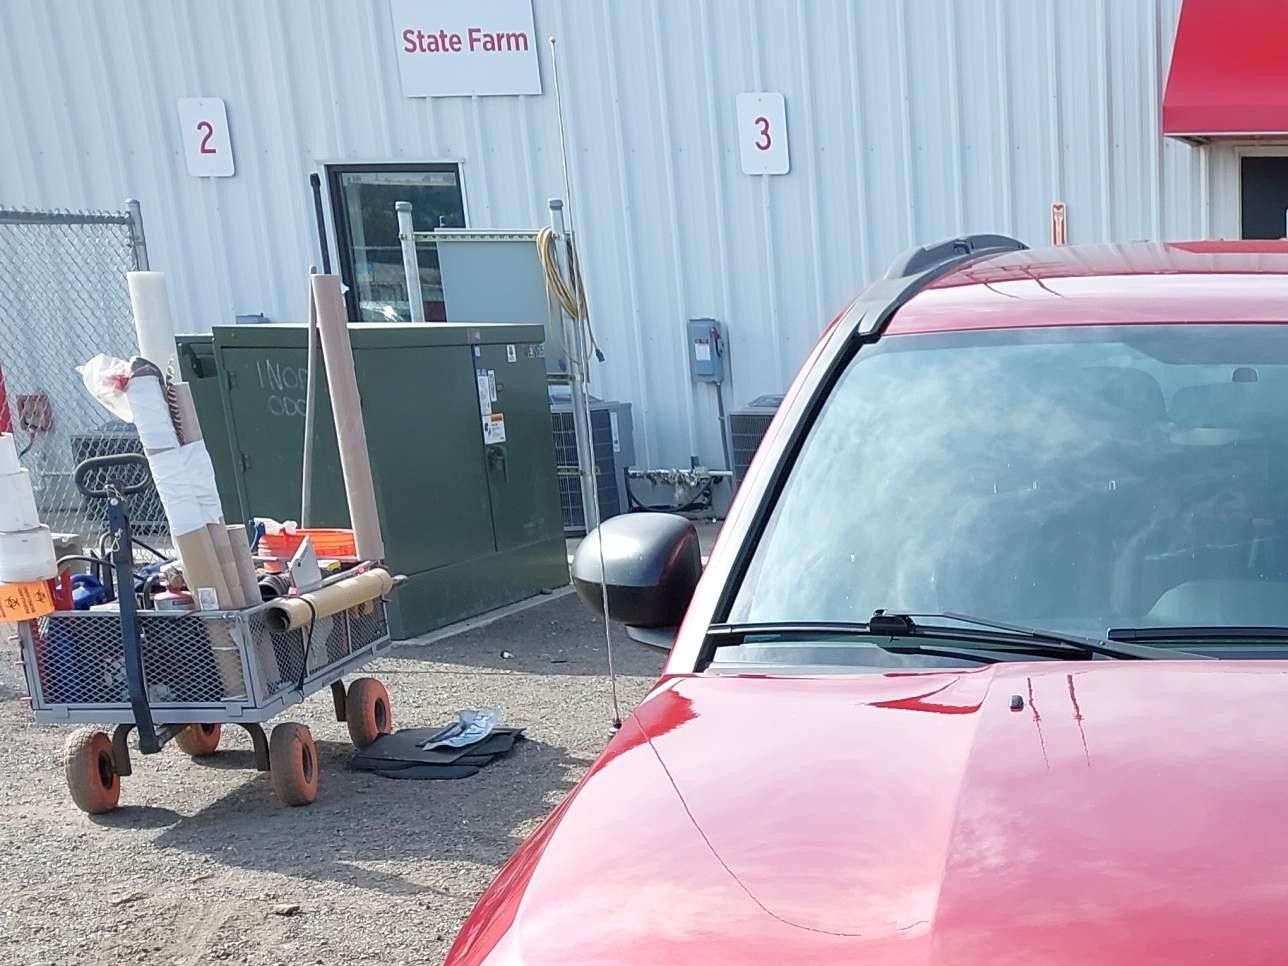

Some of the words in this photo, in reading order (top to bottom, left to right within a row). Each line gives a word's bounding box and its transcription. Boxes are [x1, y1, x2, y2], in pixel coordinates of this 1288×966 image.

[403, 28, 462, 53] State
[468, 28, 529, 52] Farm
[197, 121, 217, 154] 2
[754, 116, 772, 151] 3
